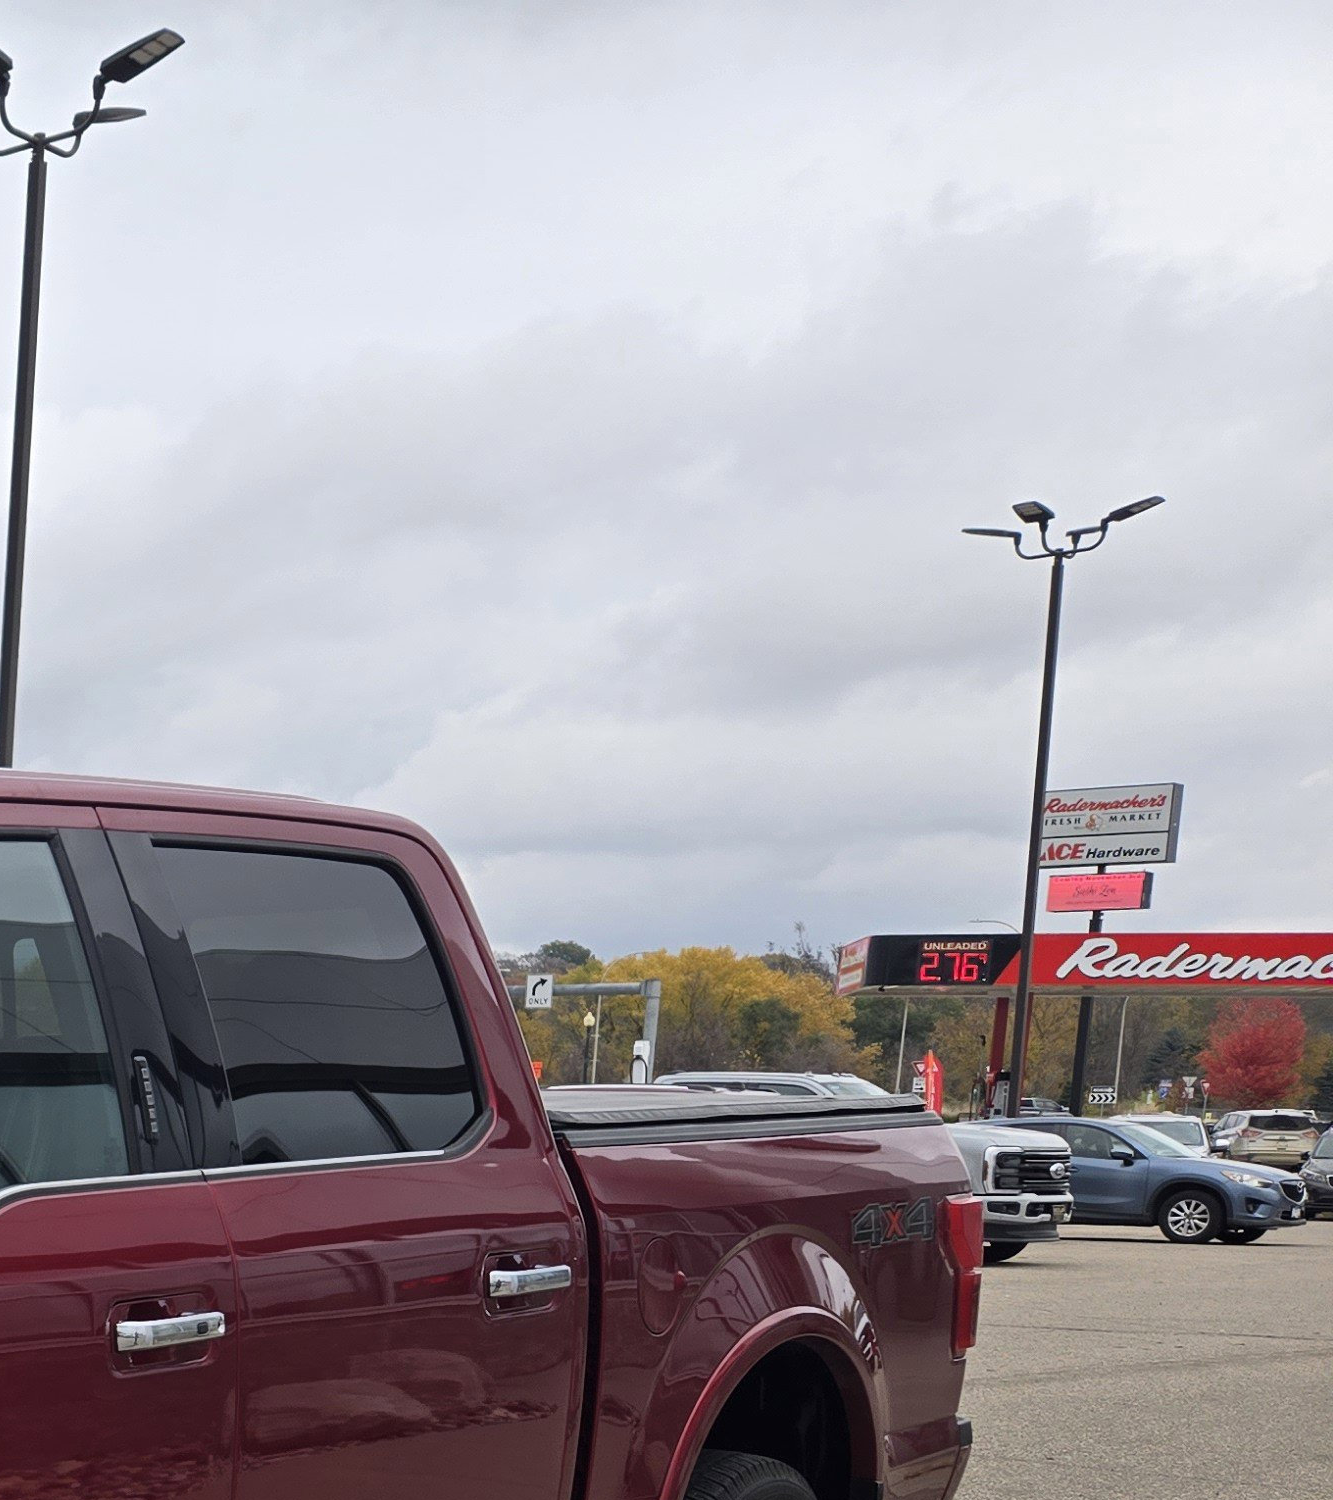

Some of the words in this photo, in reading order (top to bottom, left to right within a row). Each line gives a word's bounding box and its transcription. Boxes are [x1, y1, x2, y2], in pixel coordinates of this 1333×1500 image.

[1043, 794, 1167, 815] Radermacher's
[1108, 812, 1162, 822] MARKET
[1039, 842, 1086, 862] ACE
[1085, 846, 1161, 860] Hardware
[923, 941, 987, 951] UNLEADED
[528, 997, 549, 1006] ONLY
